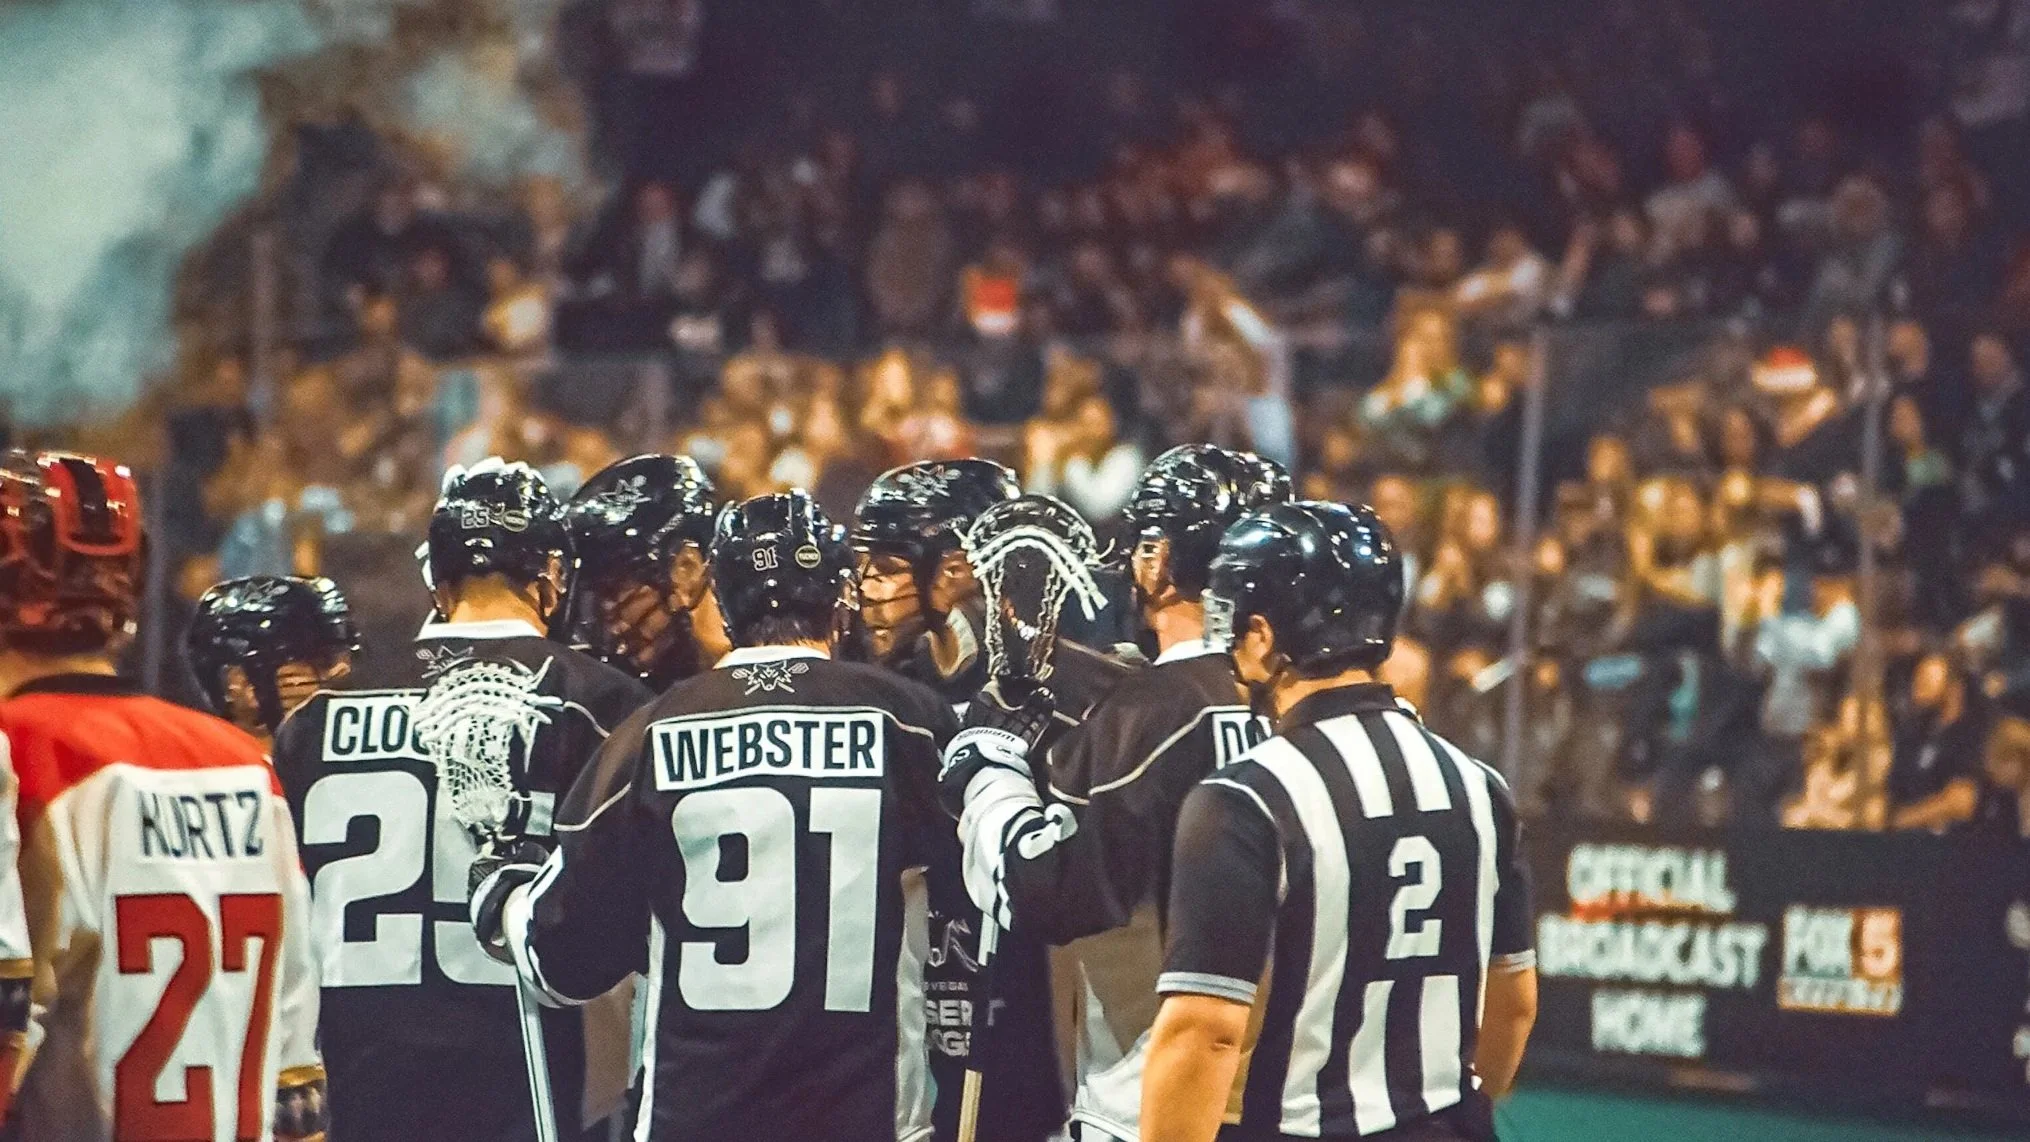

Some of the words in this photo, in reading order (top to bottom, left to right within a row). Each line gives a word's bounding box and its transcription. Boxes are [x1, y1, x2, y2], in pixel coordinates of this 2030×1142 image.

[461, 506, 490, 529] 25
[752, 545, 779, 571] 91
[660, 719, 876, 782] WEBSTER
[138, 790, 264, 859] KURTZ
[672, 787, 882, 1012] 91
[1385, 835, 1443, 960] 2
[1568, 843, 1736, 912] OFFICIAL
[1537, 914, 1769, 988] BROADCAST
[114, 892, 284, 1142] 27
[1592, 990, 1706, 1057] HOME
